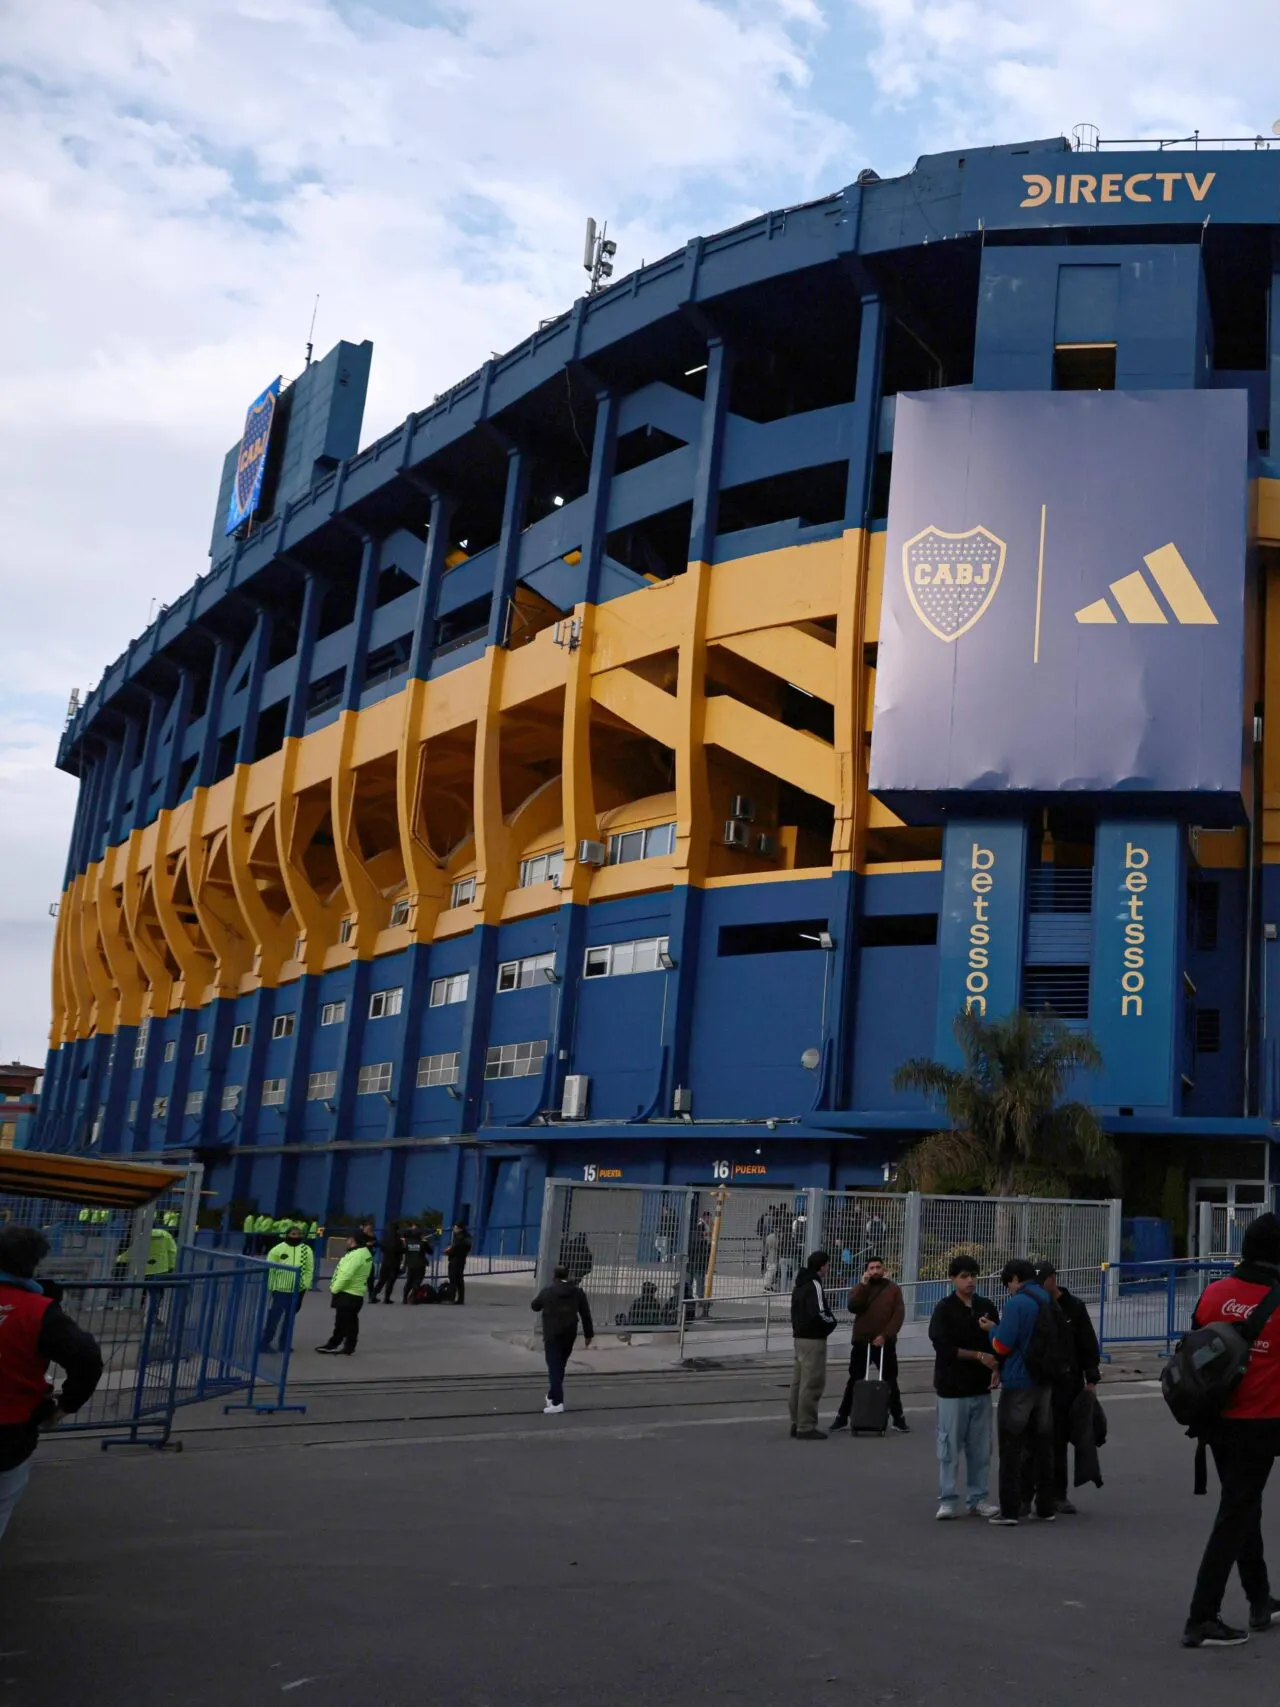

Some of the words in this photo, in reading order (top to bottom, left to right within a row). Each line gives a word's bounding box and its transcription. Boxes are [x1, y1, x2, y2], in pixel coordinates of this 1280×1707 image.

[1019, 172, 1217, 208] DIRECTV
[914, 563, 992, 585] CABJ
[965, 843, 995, 1017] betsson
[1121, 842, 1149, 1016] betsson
[583, 1164, 596, 1182] 15
[712, 1160, 729, 1179] 16
[735, 1165, 766, 1174] PUERTA
